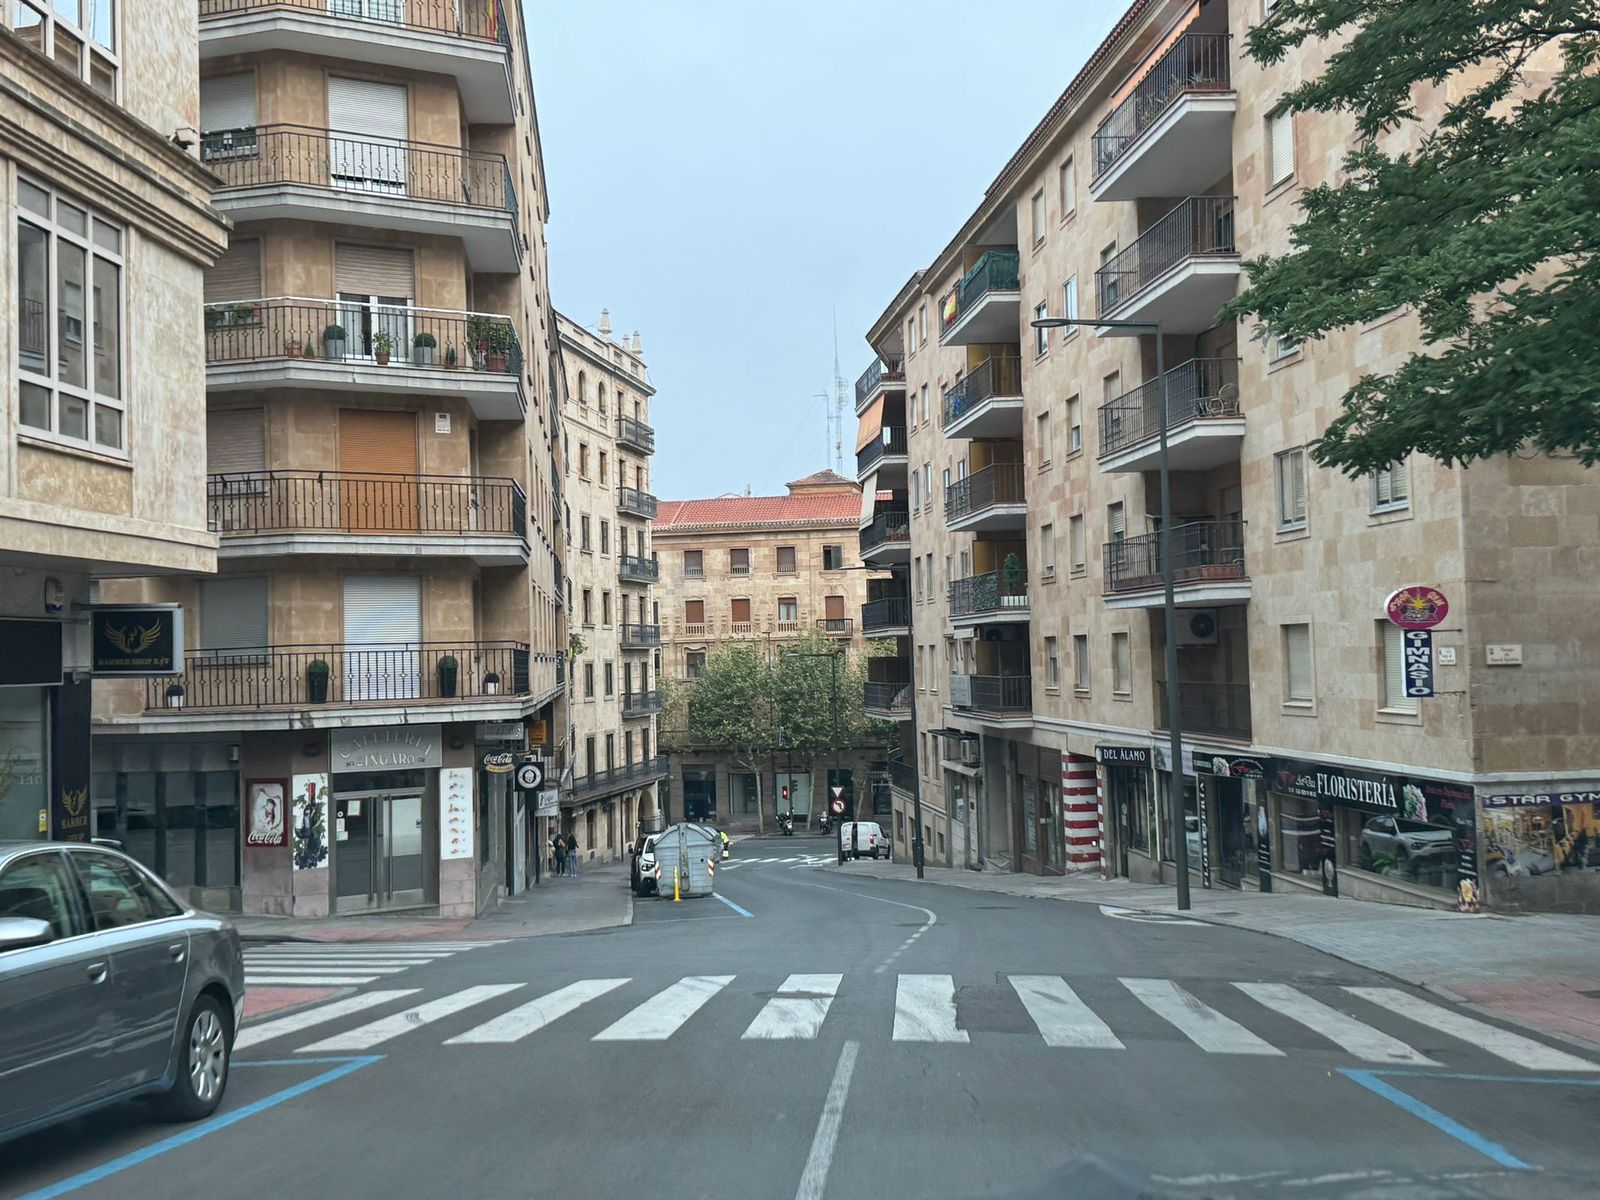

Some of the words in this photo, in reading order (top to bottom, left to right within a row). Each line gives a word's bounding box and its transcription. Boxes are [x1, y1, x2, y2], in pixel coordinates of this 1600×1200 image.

[1389, 590, 1411, 612] STAR
[1406, 631, 1431, 695] GIMNASIO
[1103, 749, 1118, 760] DEL
[1316, 772, 1398, 808] FLORISTERÍA
[1492, 795, 1552, 805] STAR
[1560, 792, 1600, 802] GYM
